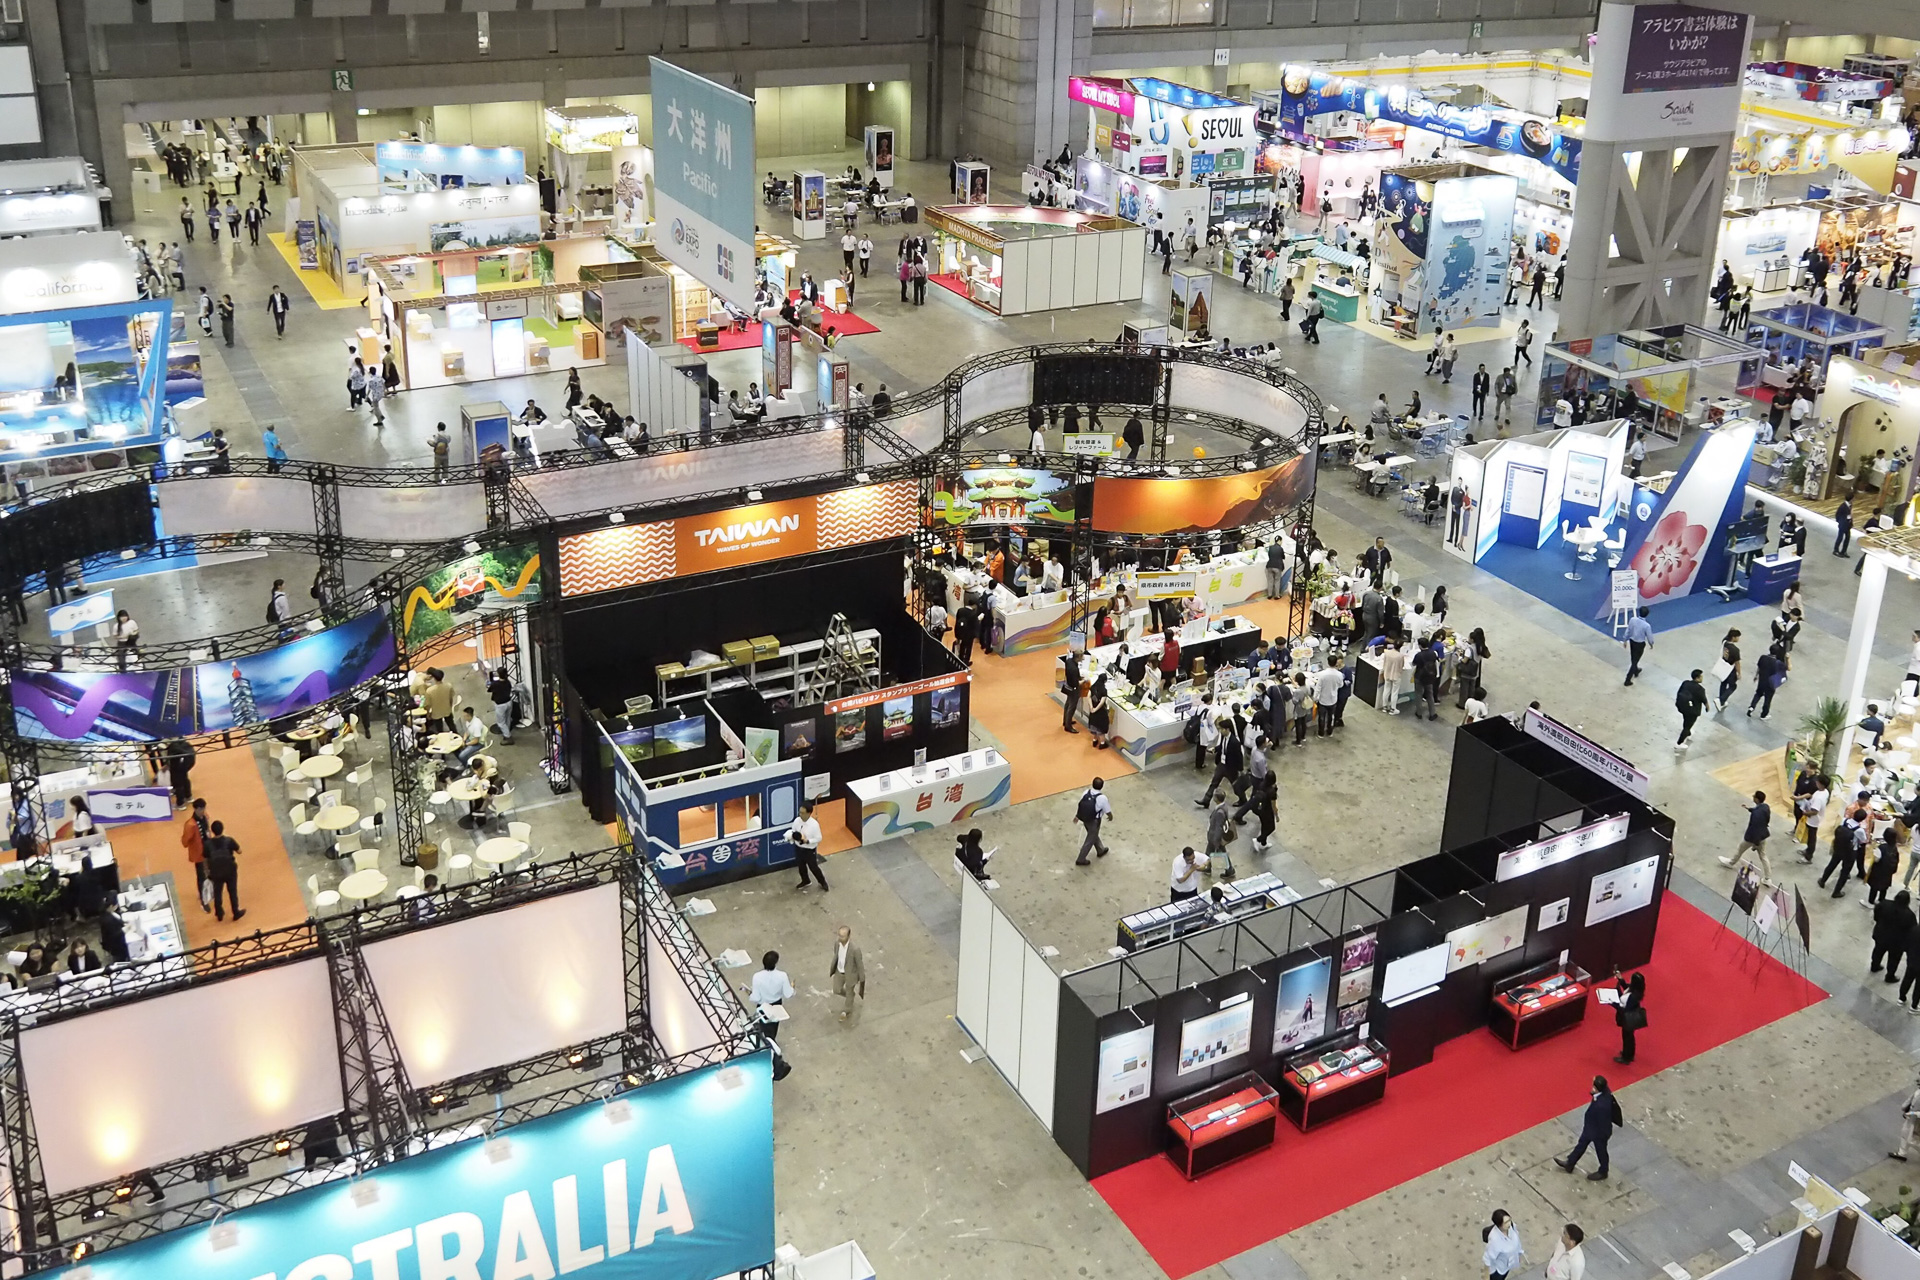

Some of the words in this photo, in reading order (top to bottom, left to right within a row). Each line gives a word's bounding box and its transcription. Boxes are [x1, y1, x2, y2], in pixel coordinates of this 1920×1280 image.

[1642, 15, 1738, 33] アラビア書芸体験は
[667, 98, 732, 171] 大洋州
[683, 161, 718, 199] Pacific
[694, 514, 799, 546] TAIWAN
[717, 545, 740, 553] WAVES
[751, 537, 781, 547] WONDER
[115, 802, 145, 810] ホテル
